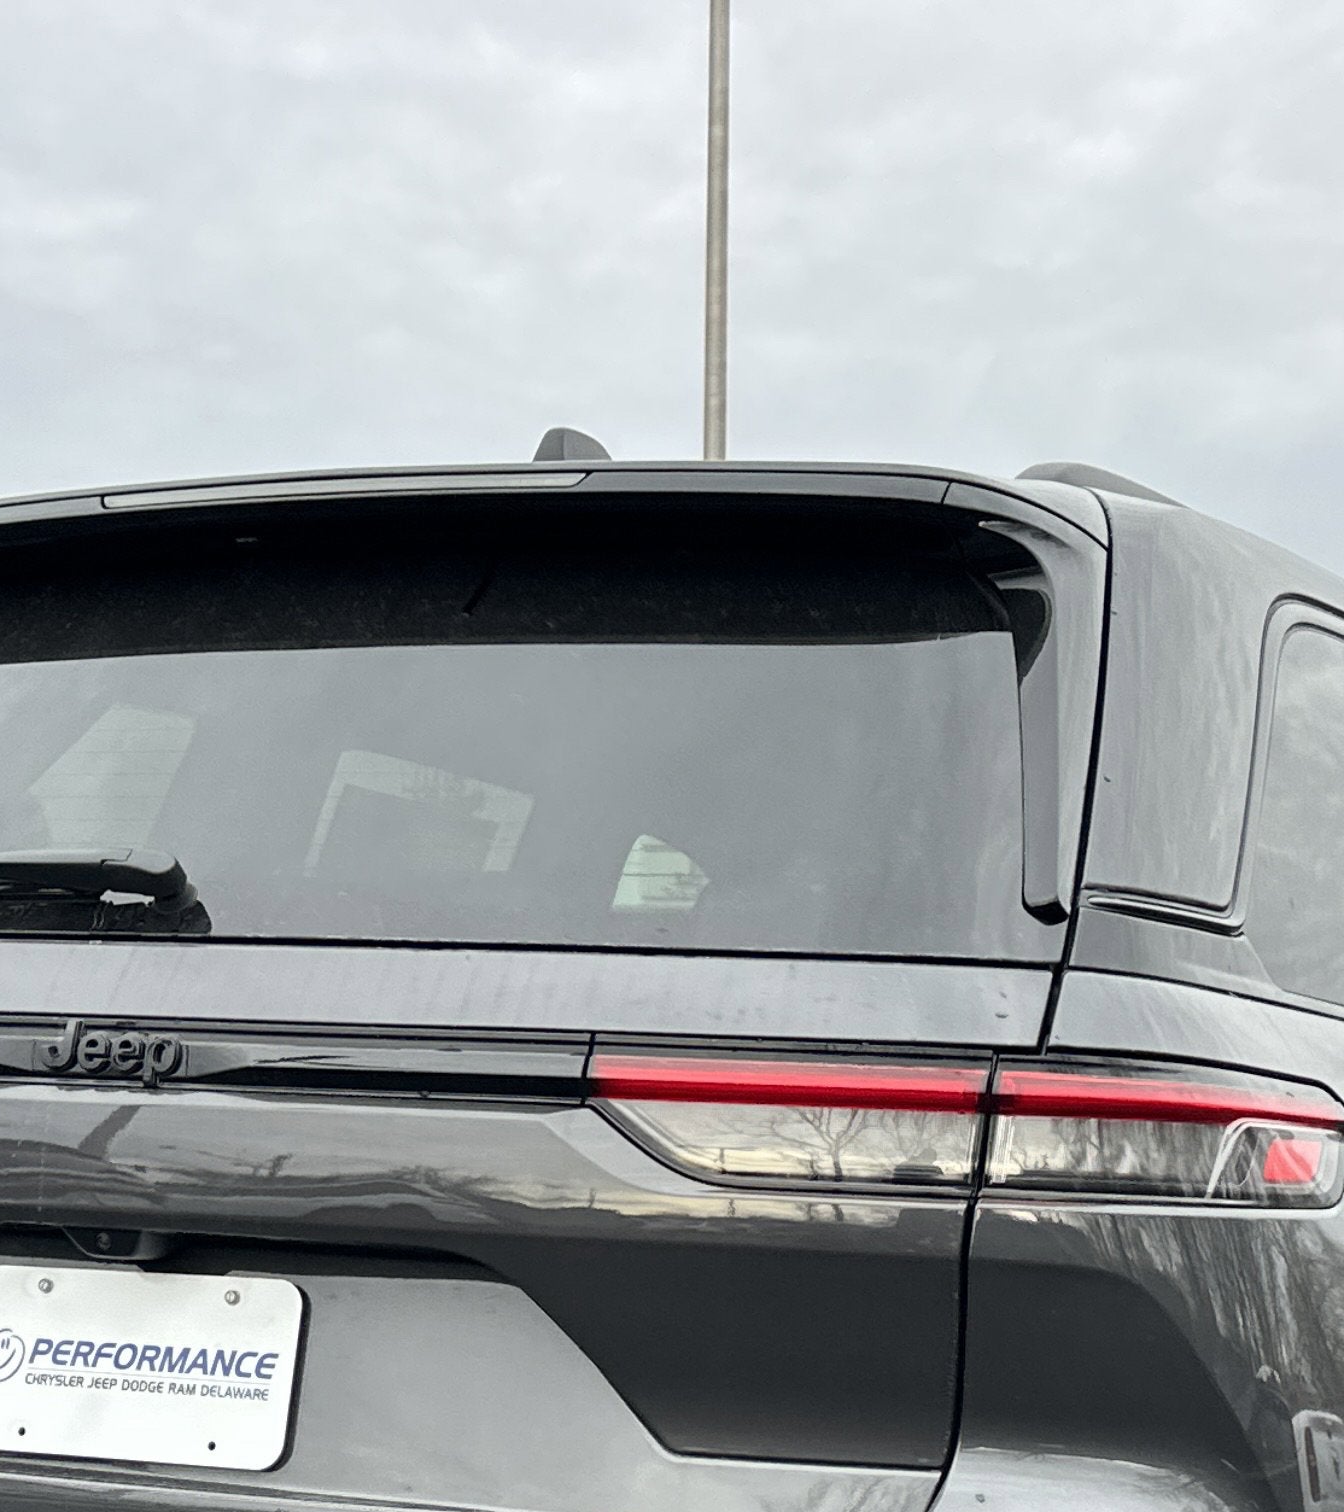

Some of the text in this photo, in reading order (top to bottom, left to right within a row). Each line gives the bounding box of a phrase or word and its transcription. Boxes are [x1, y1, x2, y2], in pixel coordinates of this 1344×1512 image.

[41, 1019, 184, 1088] Jeep
[29, 1338, 279, 1380] PERFORMANCE
[24, 1372, 269, 1401] CHRYSLER JEEP DODGE RAM DELAWARE
